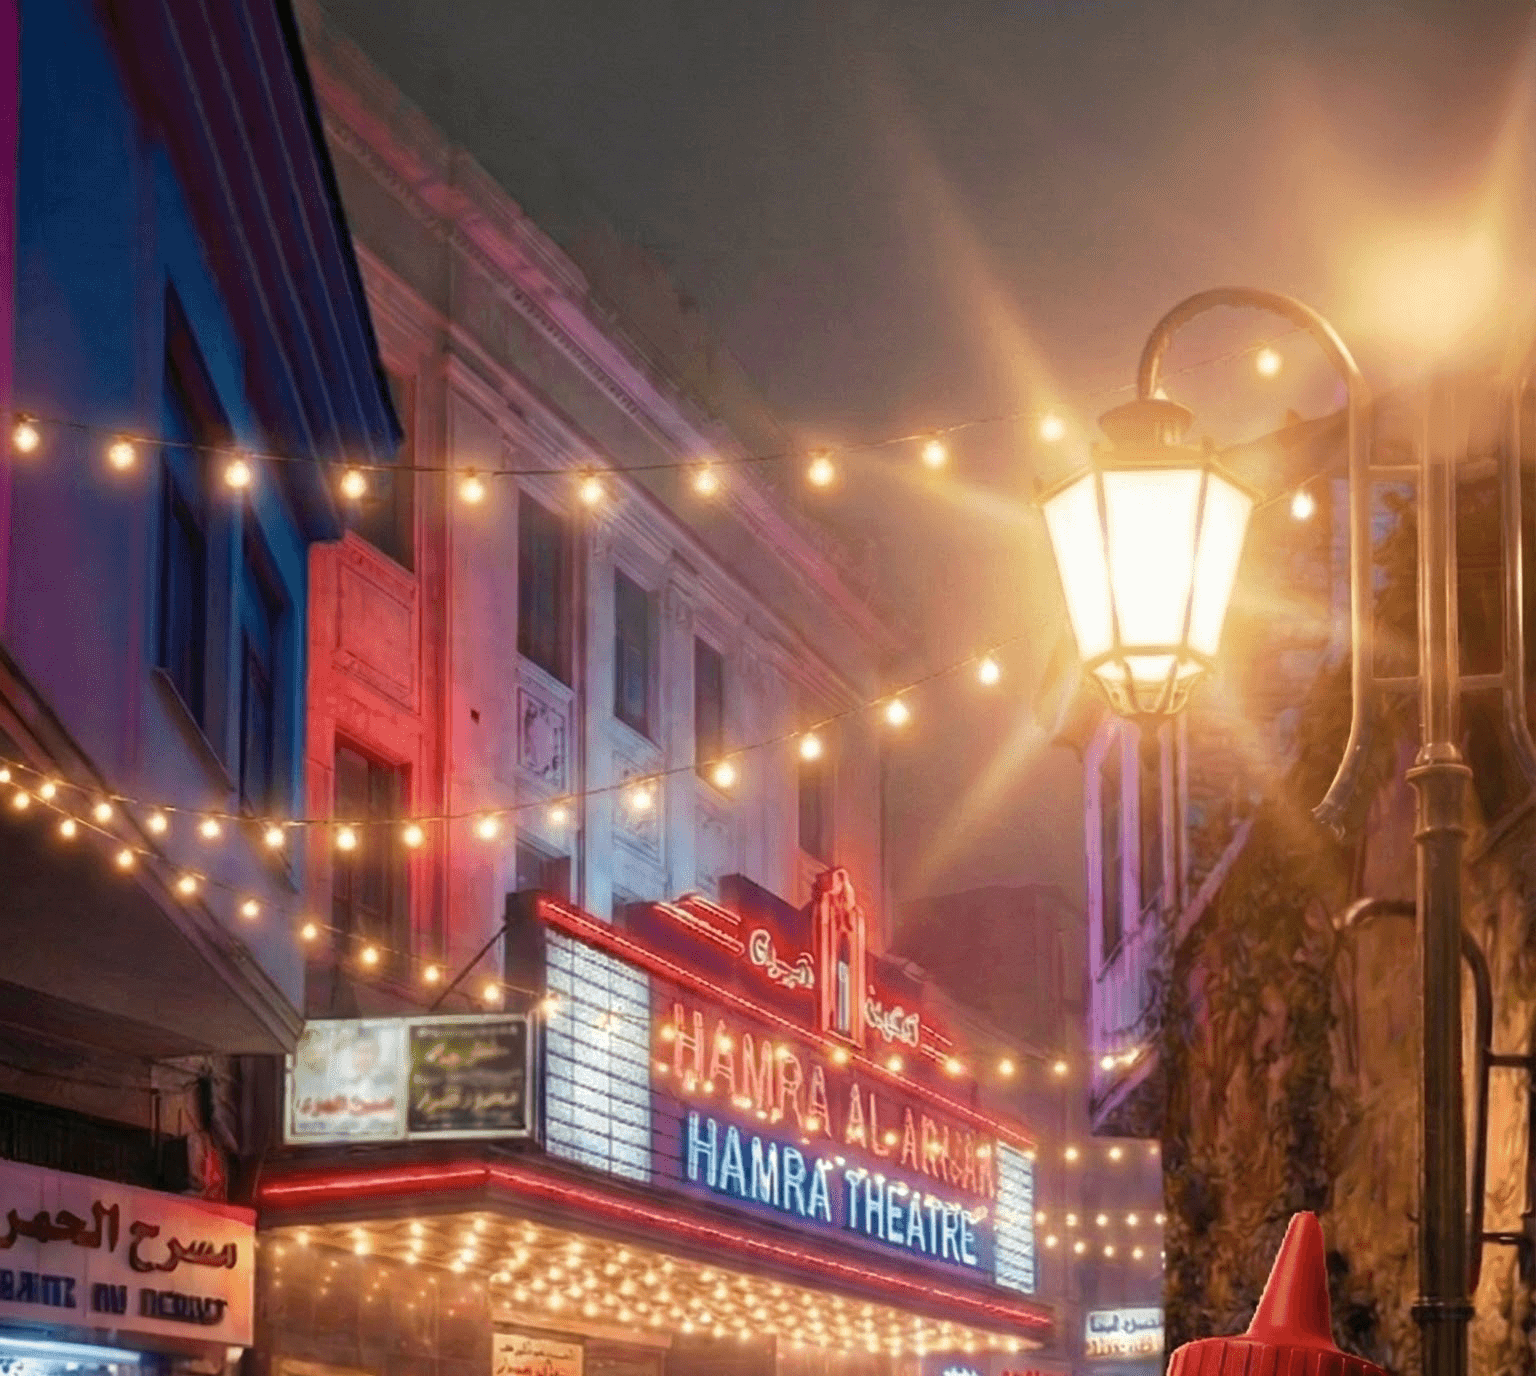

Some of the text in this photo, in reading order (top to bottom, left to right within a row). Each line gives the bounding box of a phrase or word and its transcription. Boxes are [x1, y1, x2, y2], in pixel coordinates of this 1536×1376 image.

[672, 1002, 832, 1139] HAMRA
[845, 1083, 891, 1157] AL
[687, 1111, 979, 1266] HAMRA THEATRE
